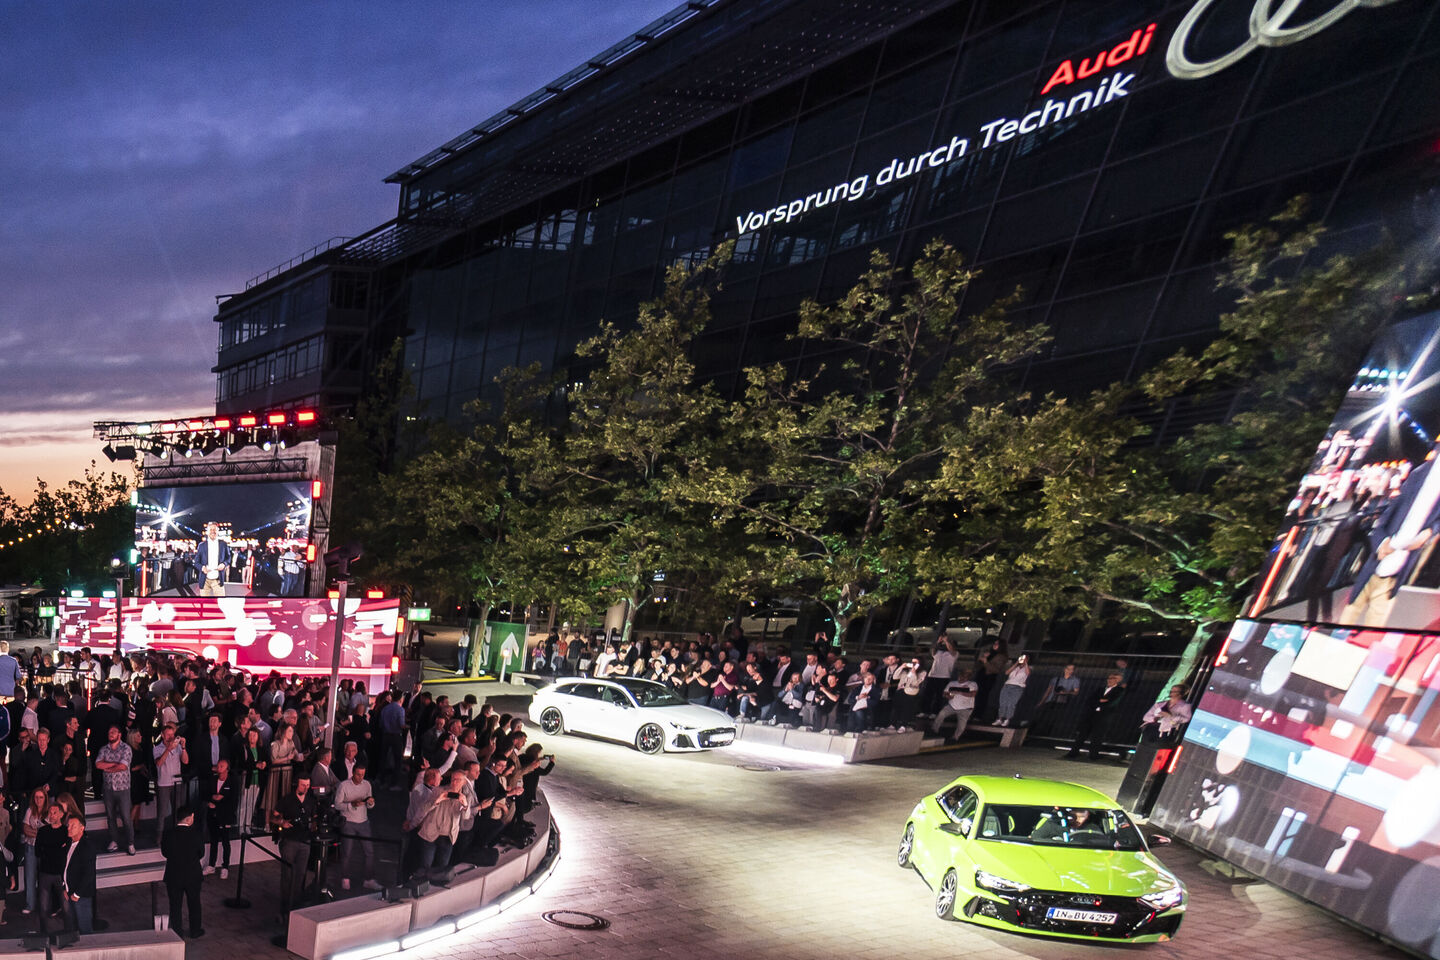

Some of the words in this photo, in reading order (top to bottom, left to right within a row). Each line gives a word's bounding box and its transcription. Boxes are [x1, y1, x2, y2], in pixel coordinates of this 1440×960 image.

[1041, 23, 1157, 95] Audi
[735, 174, 869, 235] Vorsprung
[875, 136, 968, 186] durch
[980, 72, 1135, 149] Technik
